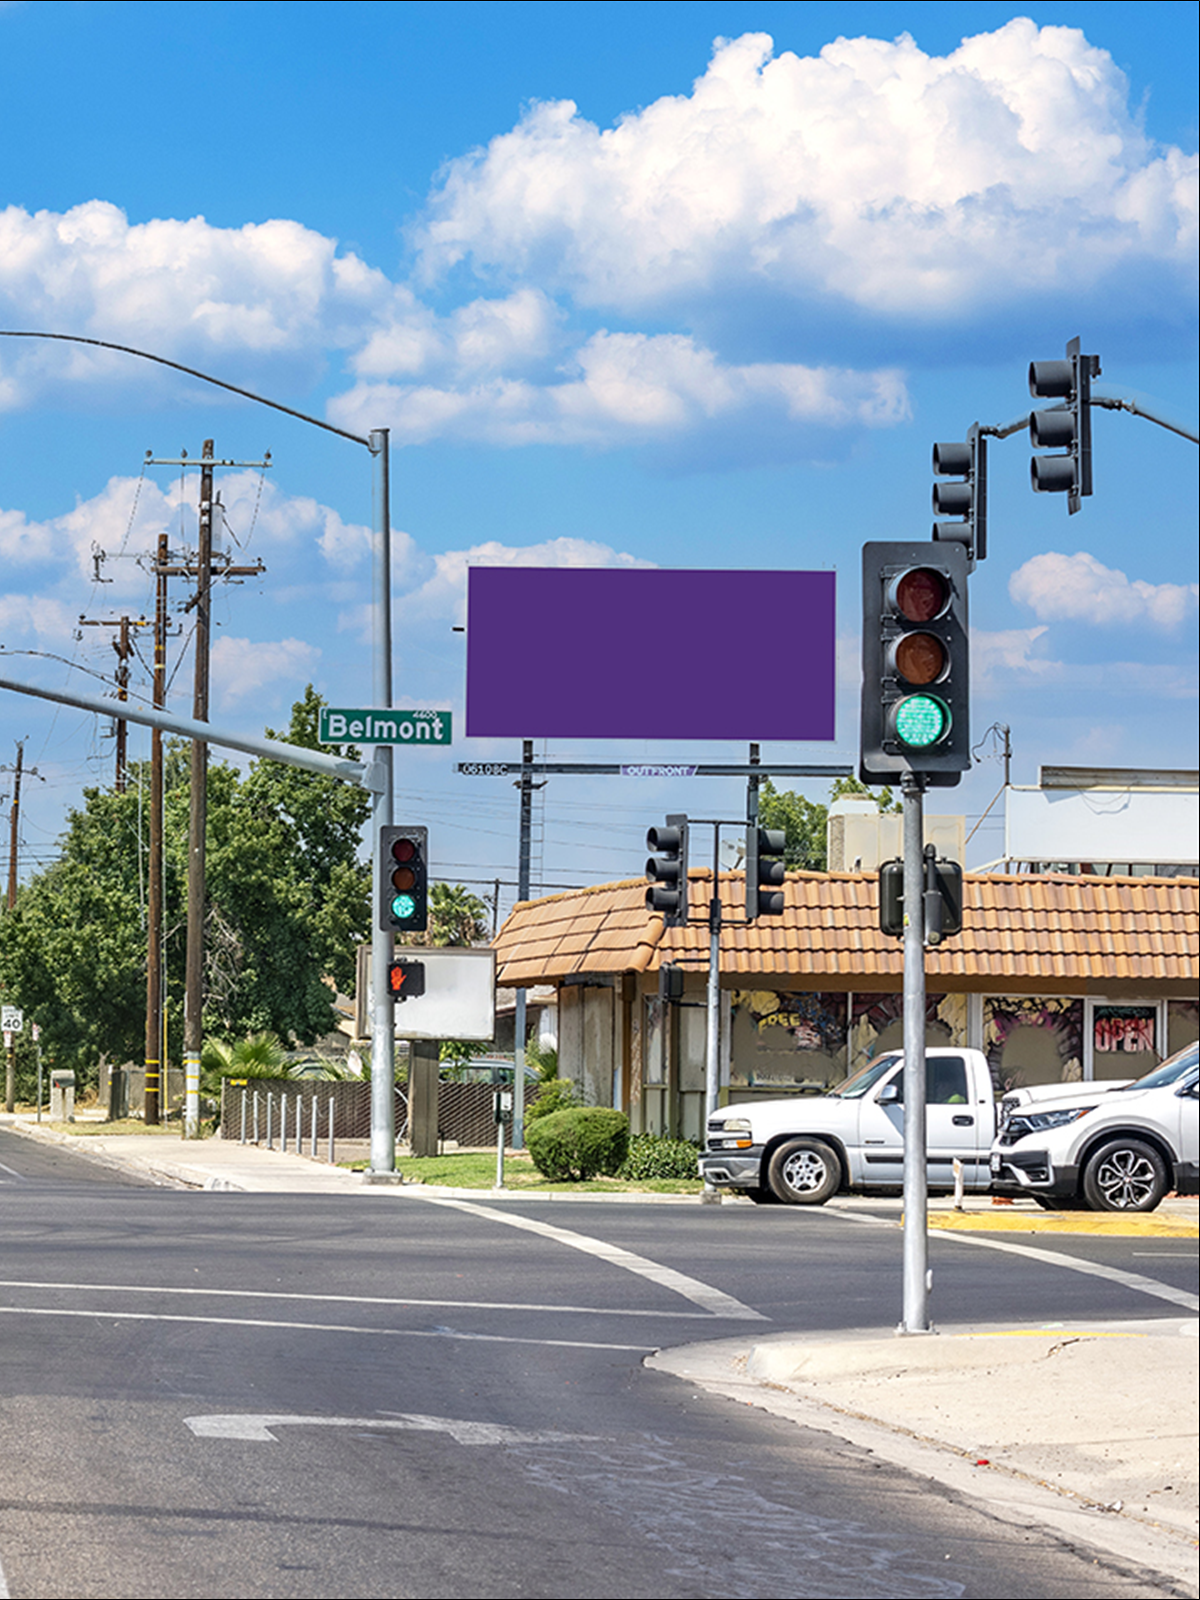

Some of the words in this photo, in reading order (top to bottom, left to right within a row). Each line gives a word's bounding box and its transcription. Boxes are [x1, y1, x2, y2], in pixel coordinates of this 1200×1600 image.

[328, 714, 444, 740] Belmont
[626, 765, 690, 777] OUTFRONT
[2, 1018, 22, 1030] 40
[1095, 1018, 1155, 1052] OPEN
